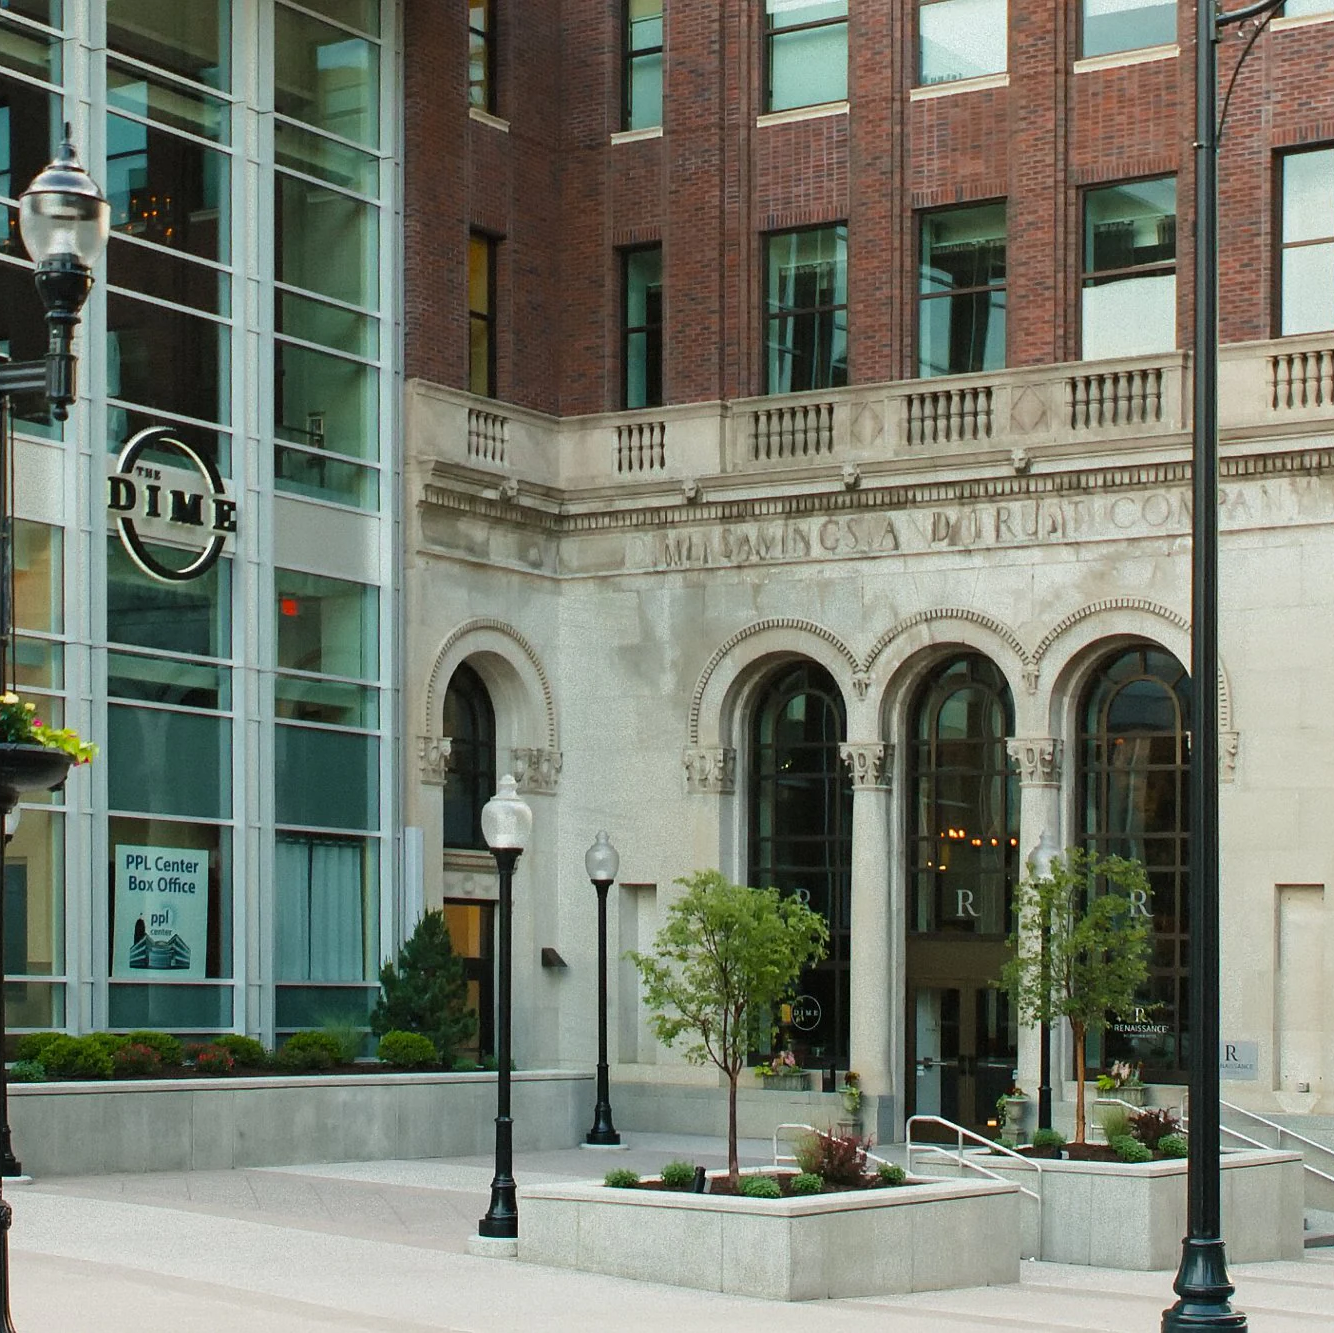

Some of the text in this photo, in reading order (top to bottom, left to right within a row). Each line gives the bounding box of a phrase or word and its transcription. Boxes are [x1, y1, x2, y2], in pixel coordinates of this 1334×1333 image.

[136, 466, 161, 480] THE
[108, 476, 237, 532] DIME
[126, 854, 199, 874] PPL Center
[128, 875, 196, 893] Box Office
[956, 889, 981, 917] R
[1130, 888, 1155, 917] R
[151, 909, 169, 927] ppl
[794, 1009, 818, 1017] DIME
[1114, 1024, 1168, 1034] RENAISSANCE
[1225, 1044, 1239, 1062] R
